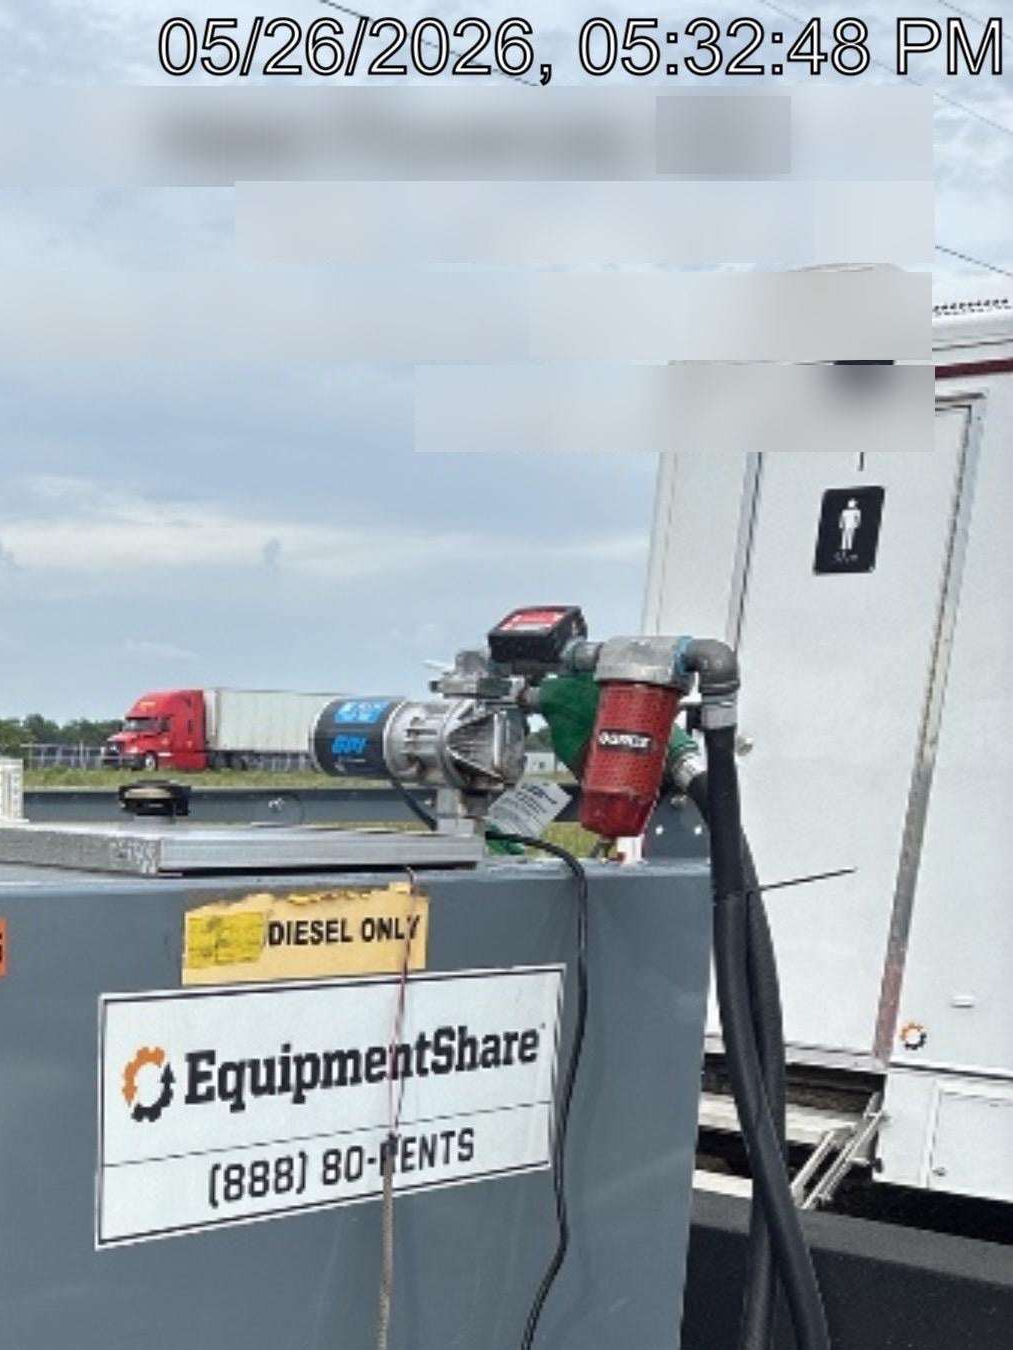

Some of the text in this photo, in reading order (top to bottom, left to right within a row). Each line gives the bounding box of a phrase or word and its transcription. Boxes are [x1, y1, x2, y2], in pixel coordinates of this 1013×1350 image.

[268, 919, 352, 947] DIESEL
[361, 914, 420, 942] ONLY
[185, 1023, 540, 1112] EquipmentShare
[209, 1151, 306, 1208] (888)
